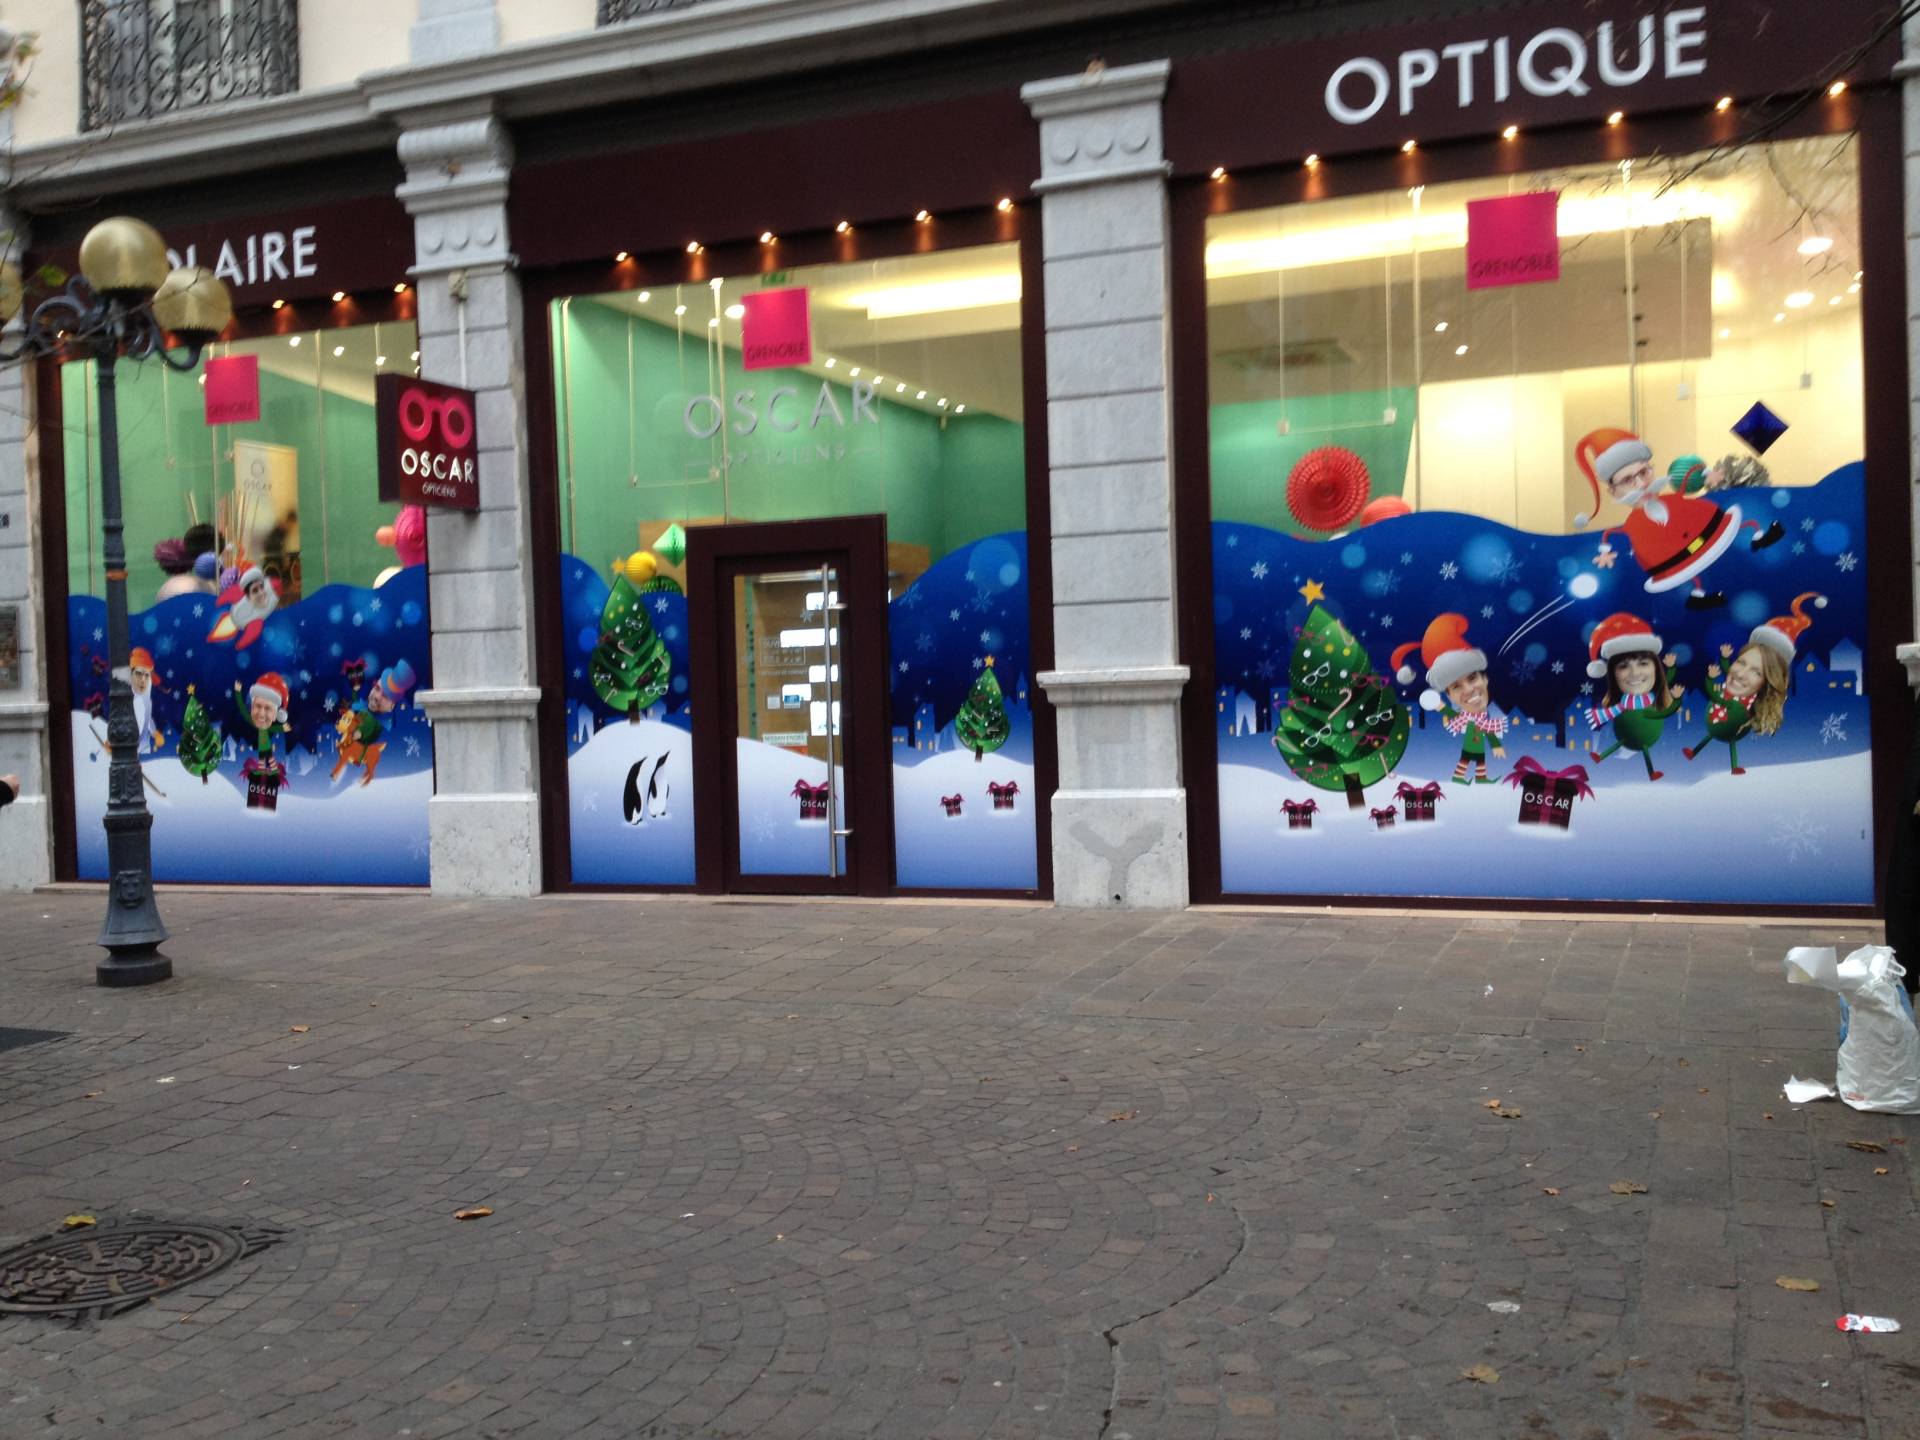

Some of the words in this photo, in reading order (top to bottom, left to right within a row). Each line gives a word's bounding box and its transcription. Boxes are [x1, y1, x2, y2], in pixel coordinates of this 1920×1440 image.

[1324, 7, 1709, 125] OPTIQUE
[165, 225, 318, 287] AIRE
[684, 381, 879, 439] OSCAR
[401, 448, 475, 484] OSCAR
[250, 784, 277, 797] OSCAR
[1406, 801, 1433, 809] OSCAR
[1524, 792, 1569, 810] OSCAR
